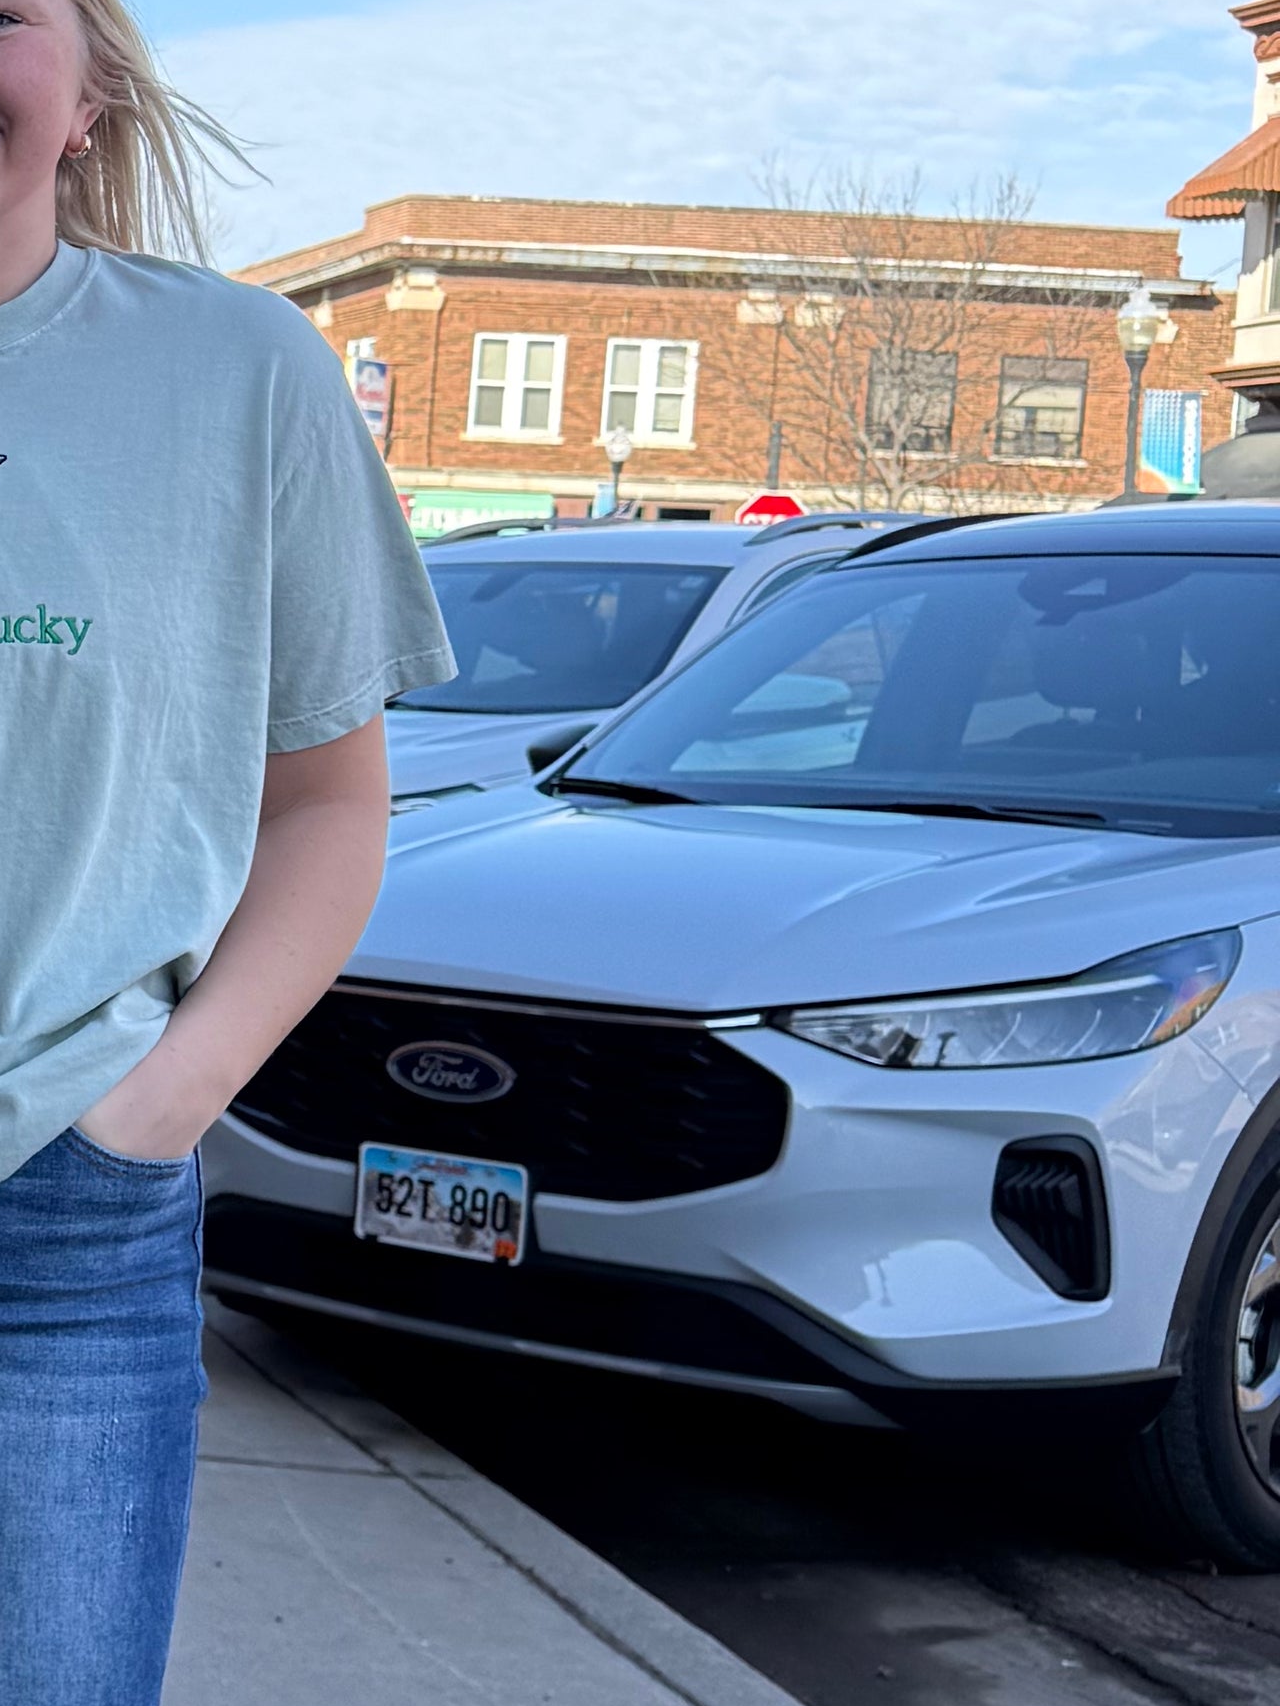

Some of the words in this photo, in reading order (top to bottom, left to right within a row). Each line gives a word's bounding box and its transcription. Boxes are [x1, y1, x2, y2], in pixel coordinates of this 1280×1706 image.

[411, 1052, 479, 1090] Ford
[375, 1172, 436, 1220] 52T
[449, 1184, 511, 1233] 890
